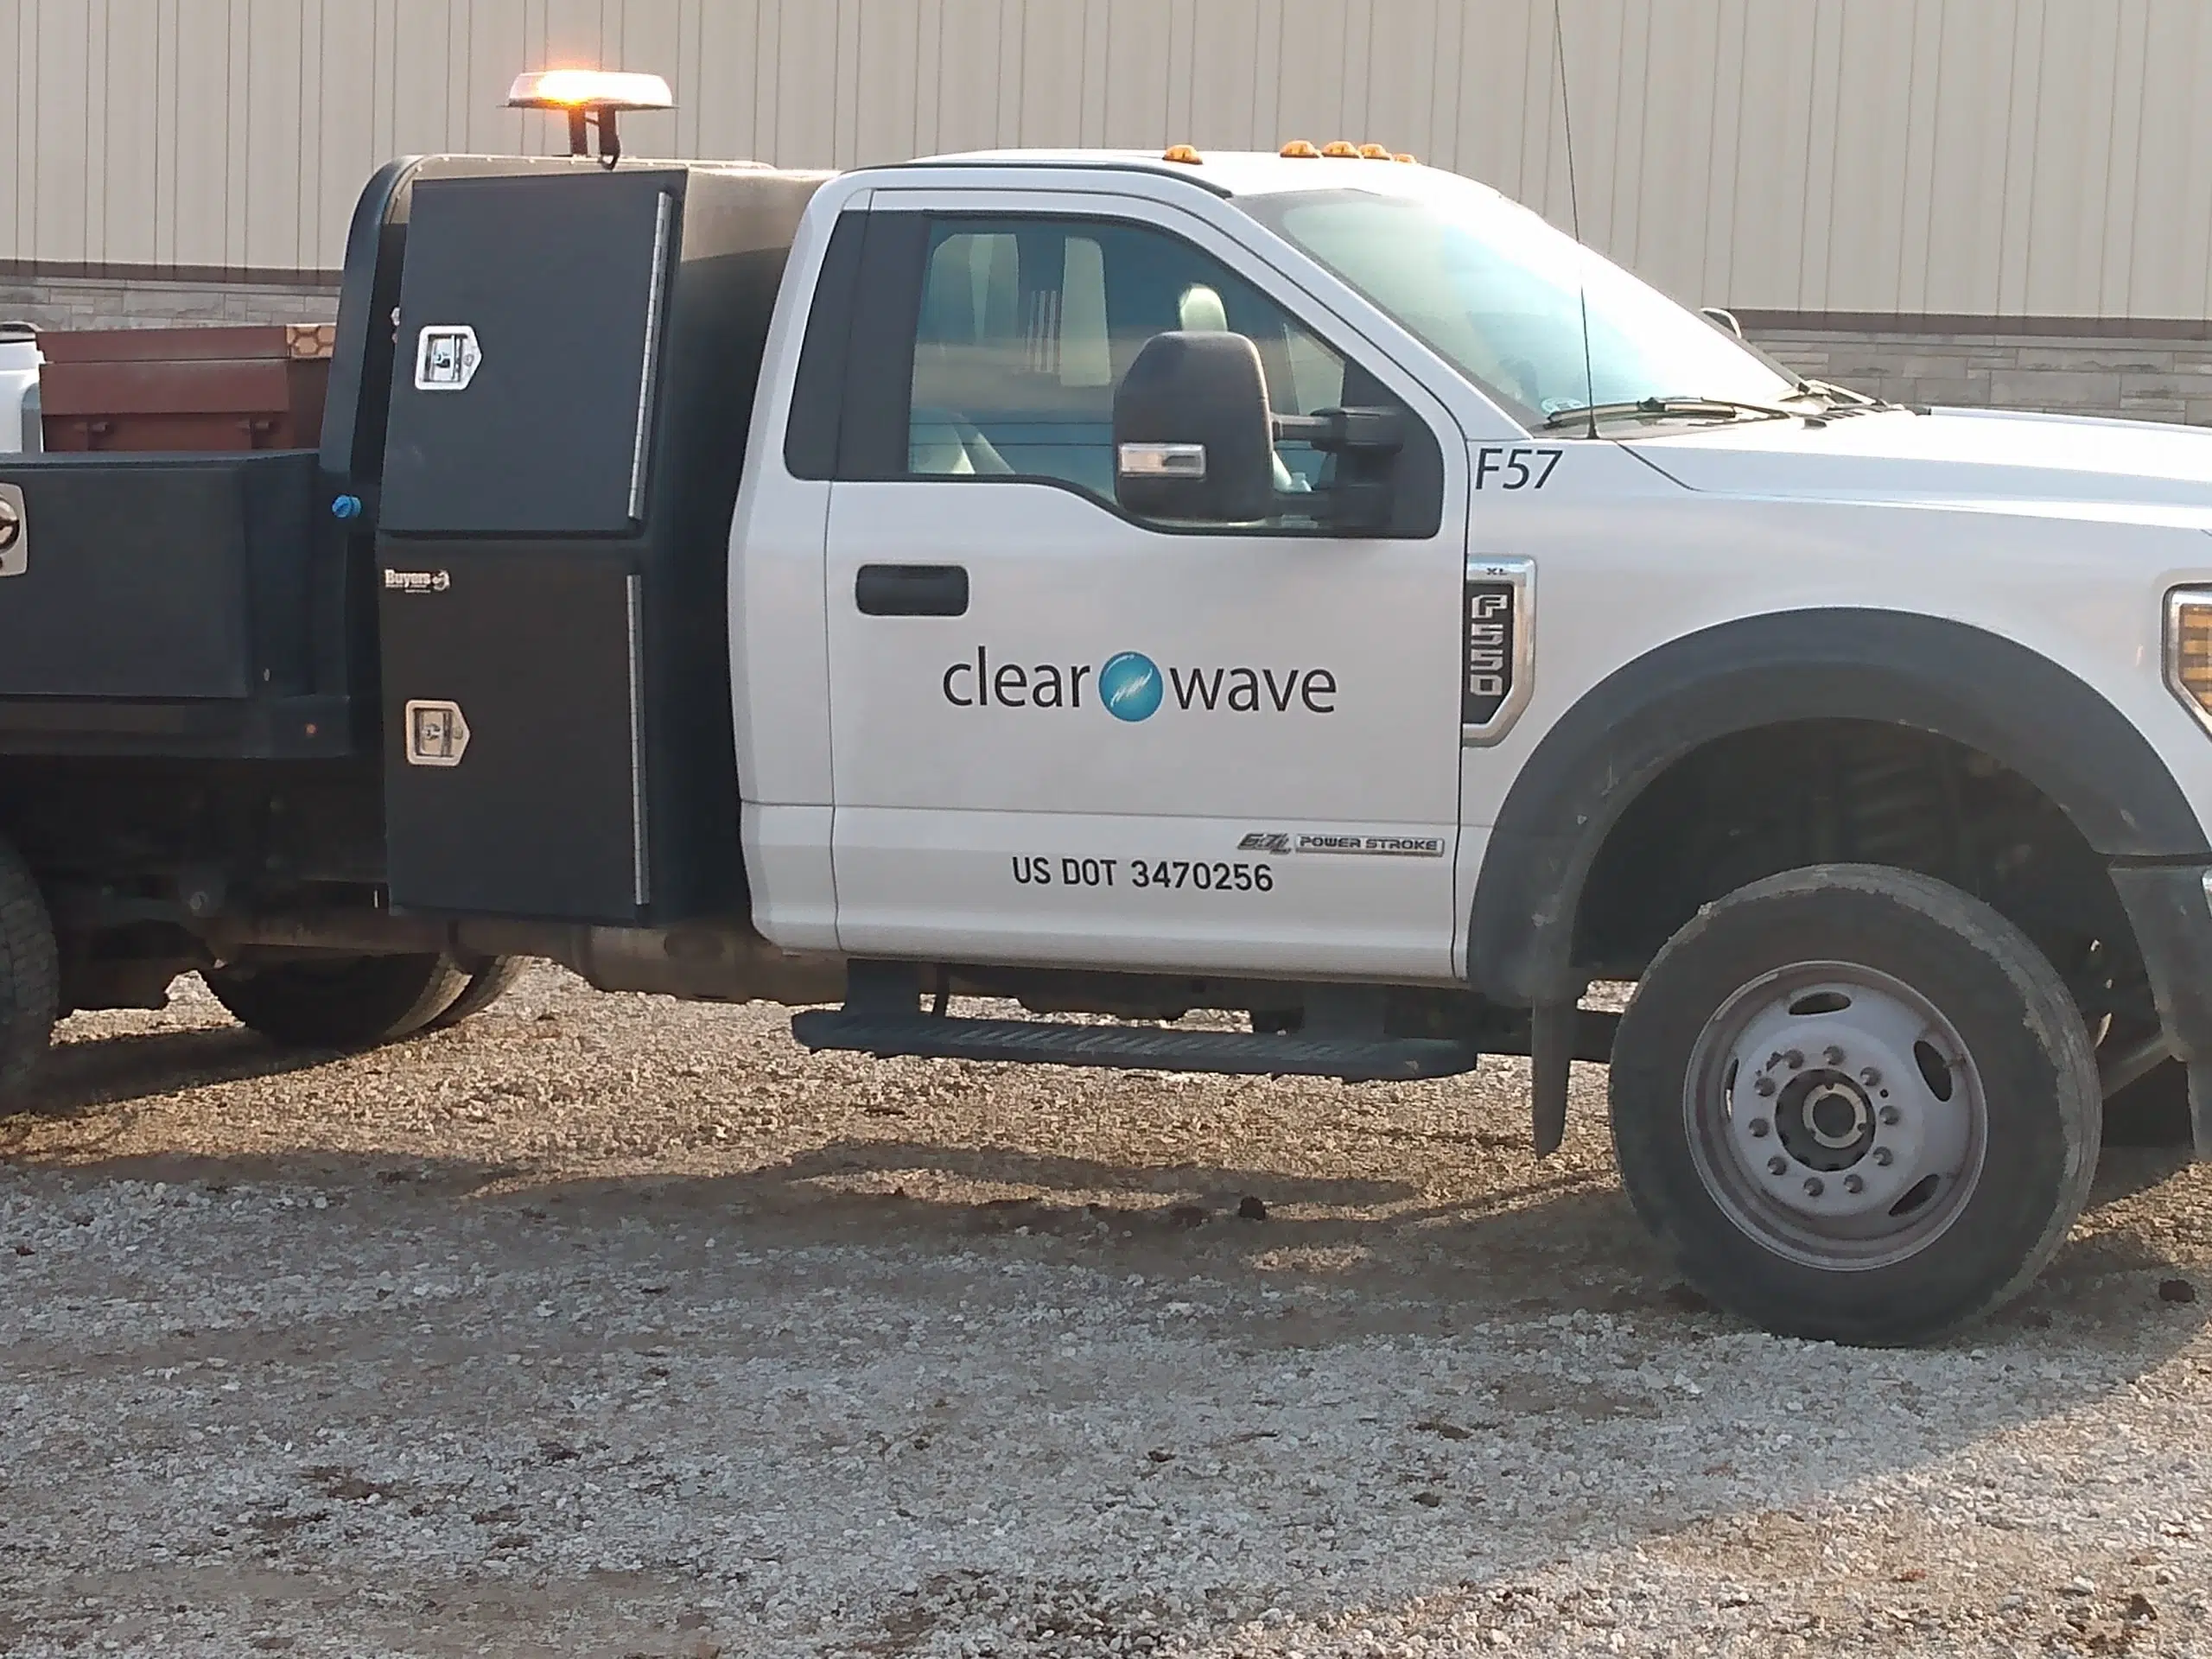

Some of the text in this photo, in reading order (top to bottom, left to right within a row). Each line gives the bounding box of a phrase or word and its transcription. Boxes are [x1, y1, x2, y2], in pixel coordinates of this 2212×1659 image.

[1475, 448, 1563, 490] F57
[385, 569, 431, 588] Buyers
[1470, 594, 1508, 696] F550
[943, 645, 1338, 713] clear wave
[1300, 836, 1361, 849] POWER
[1366, 839, 1437, 851] STROKE
[1013, 856, 1274, 892] US DOT 3470256
